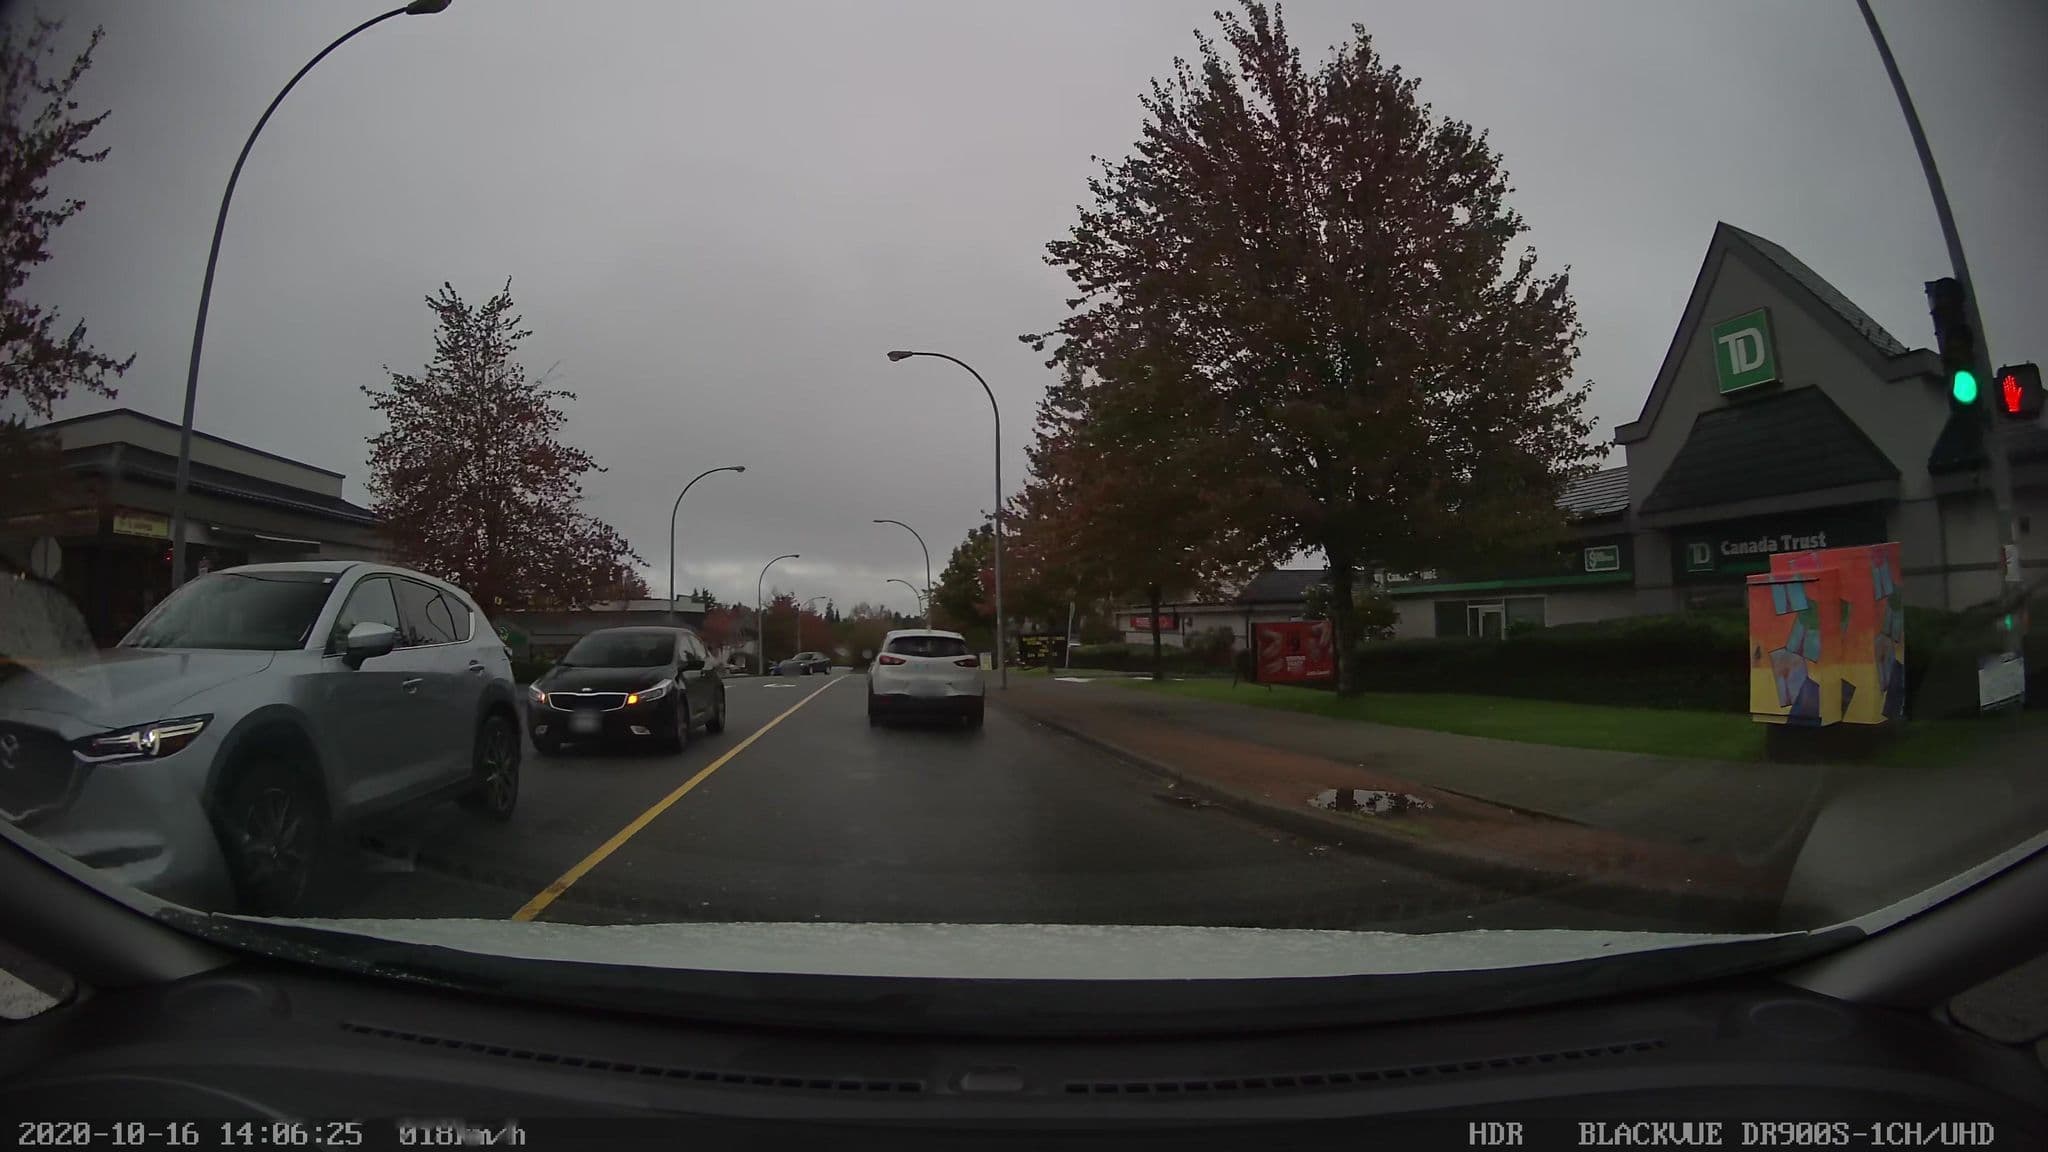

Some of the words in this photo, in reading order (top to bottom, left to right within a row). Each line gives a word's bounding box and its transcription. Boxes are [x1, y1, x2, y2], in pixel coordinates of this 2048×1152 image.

[1719, 327, 1765, 374] TD
[1721, 537, 1777, 555] Canada
[1781, 531, 1826, 551] Trust
